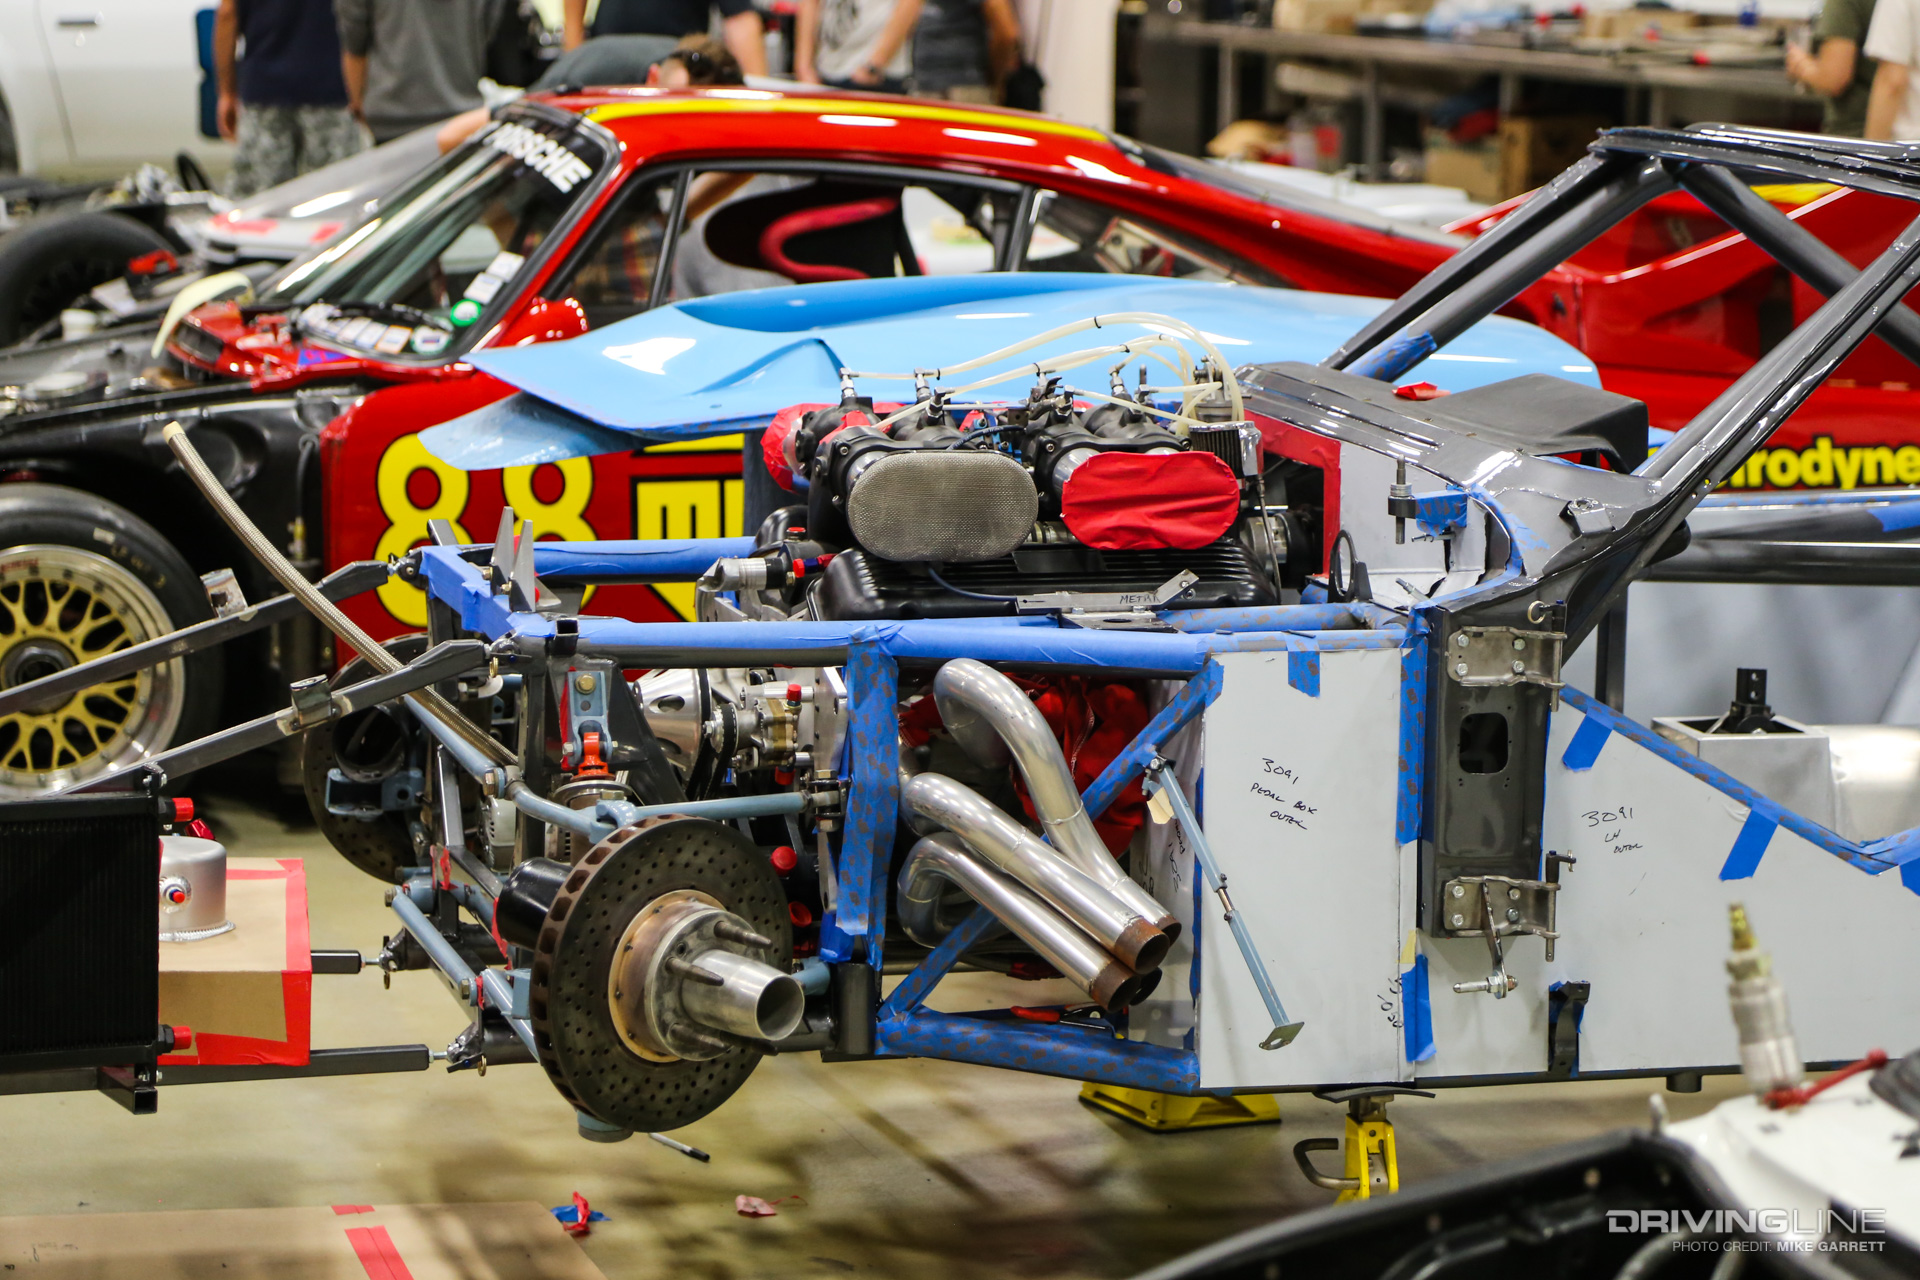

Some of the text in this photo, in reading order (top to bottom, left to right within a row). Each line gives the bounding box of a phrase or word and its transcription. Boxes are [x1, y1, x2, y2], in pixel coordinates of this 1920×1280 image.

[483, 122, 593, 193] PORSCHE
[1262, 757, 1299, 785] 3091
[1250, 782, 1318, 815] PEDAL BOX
[1581, 806, 1634, 828] 3091
